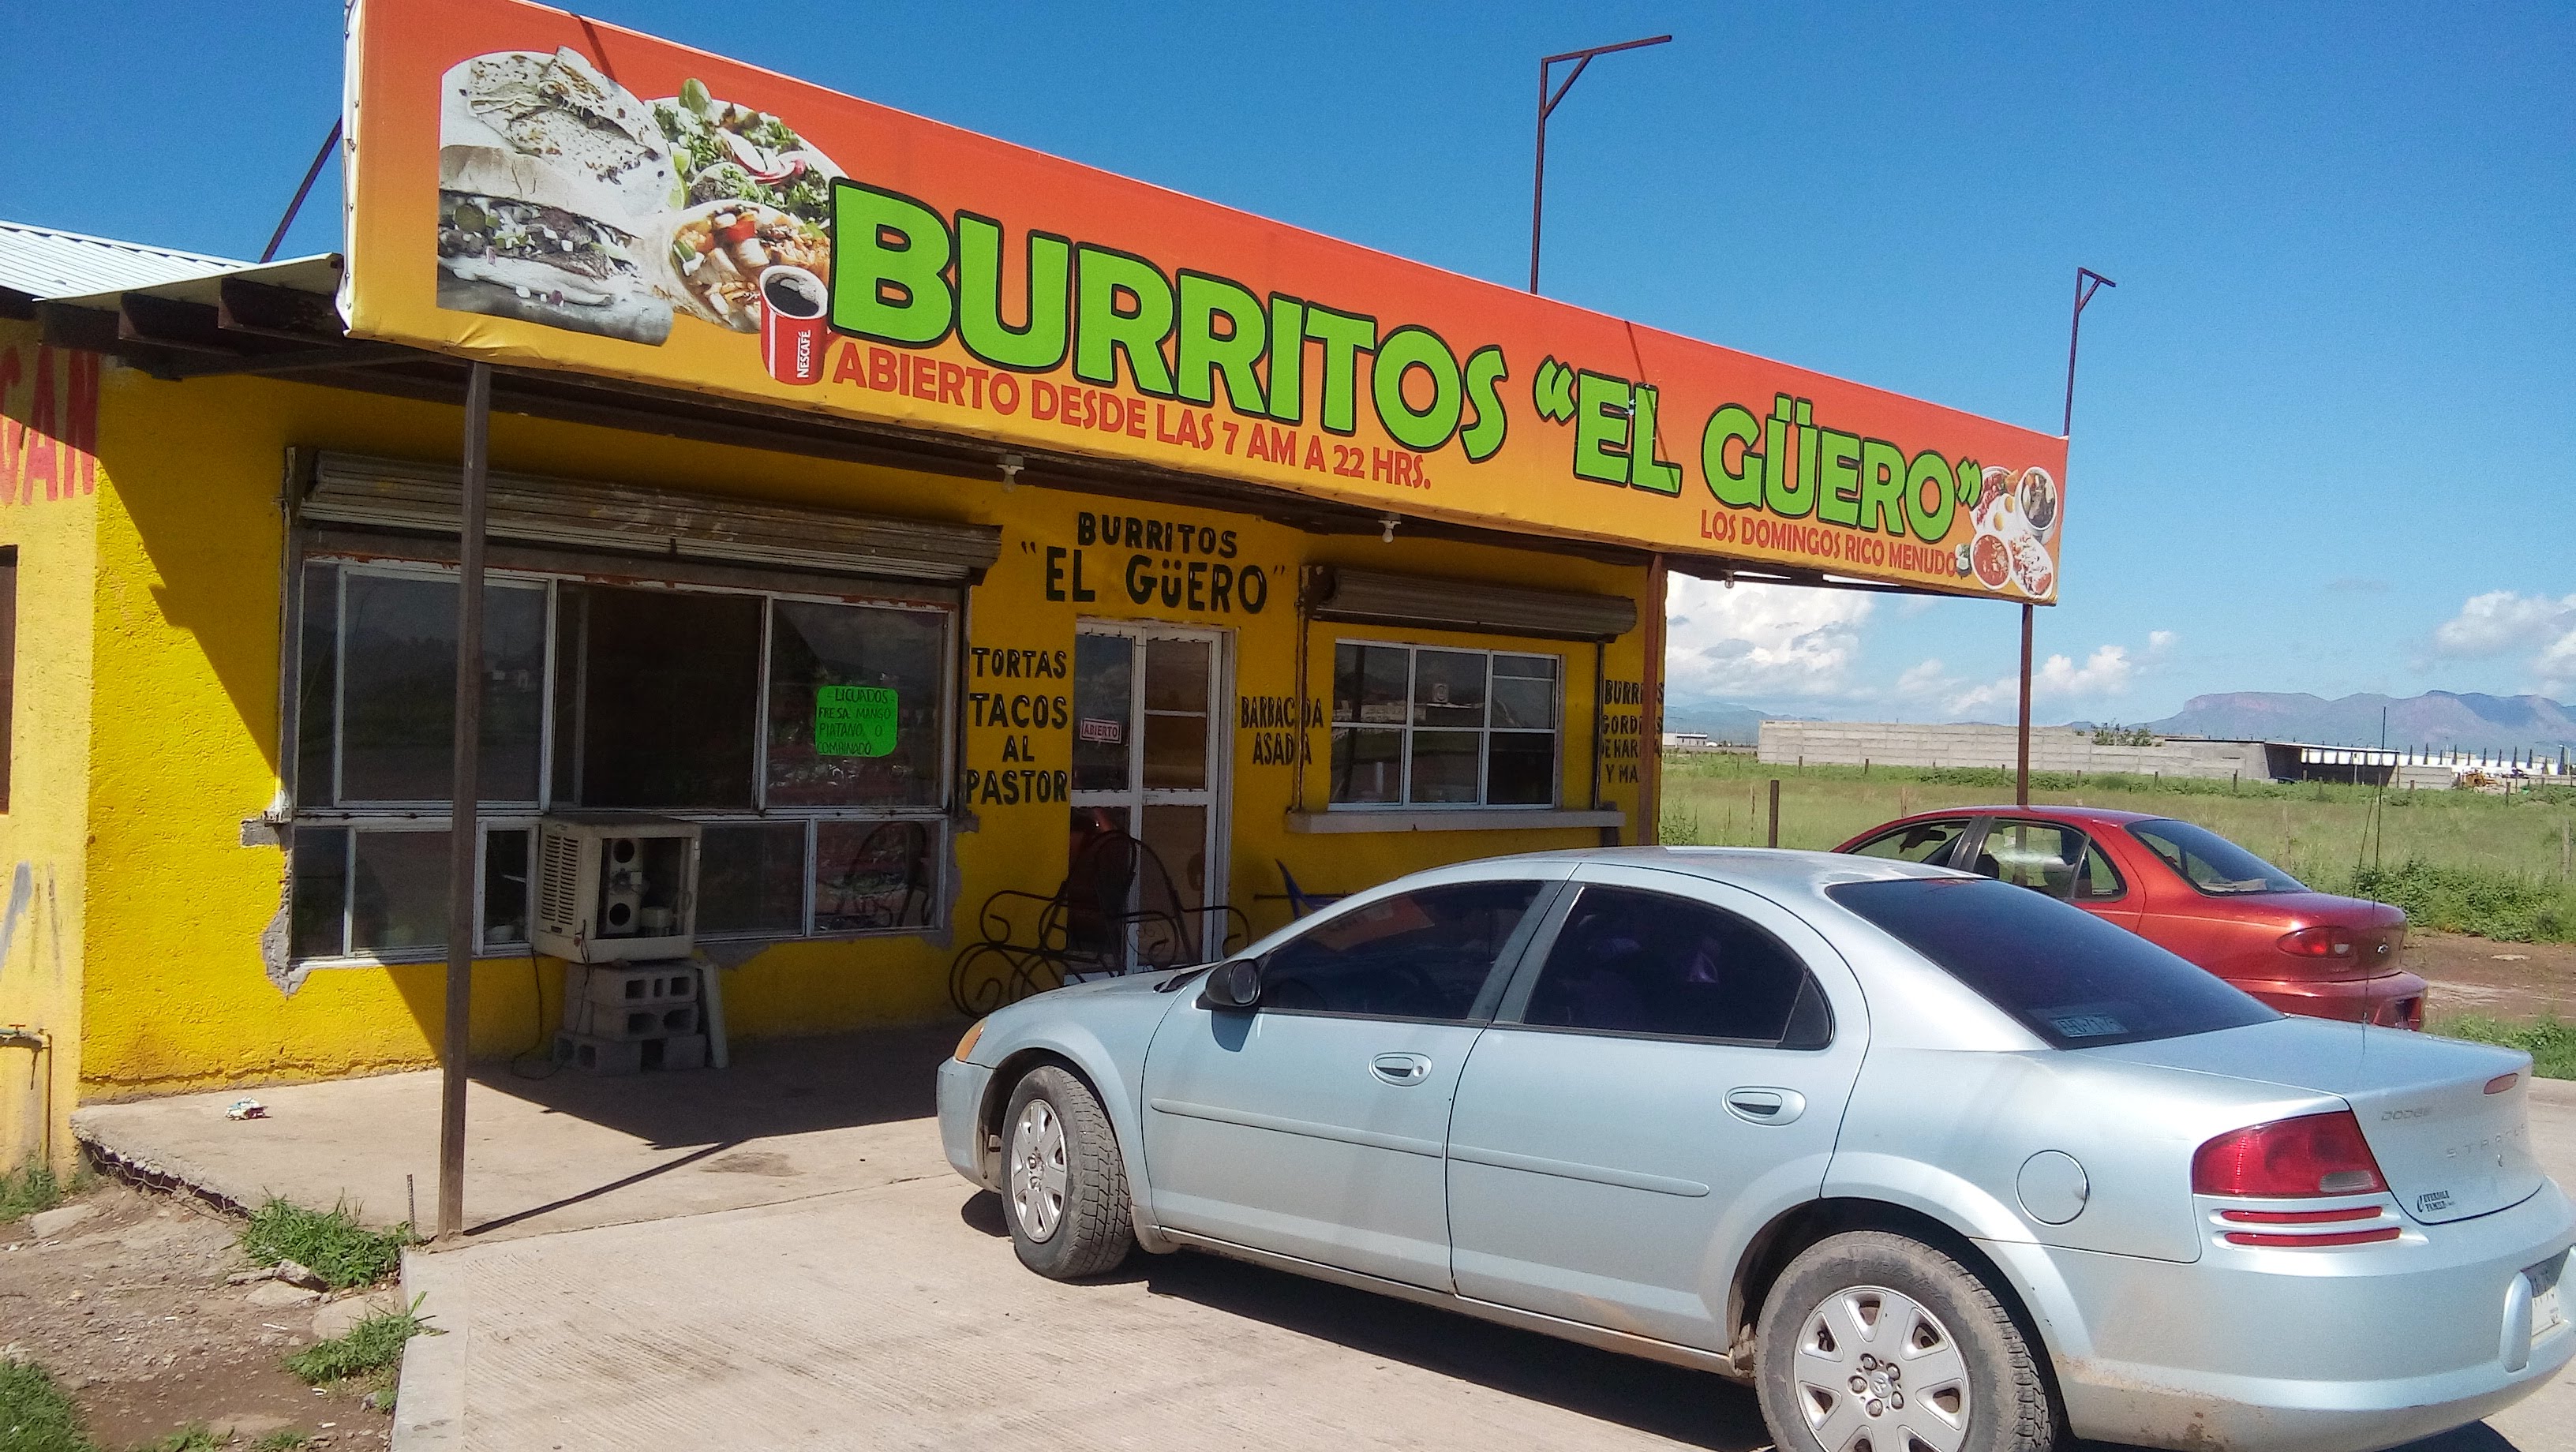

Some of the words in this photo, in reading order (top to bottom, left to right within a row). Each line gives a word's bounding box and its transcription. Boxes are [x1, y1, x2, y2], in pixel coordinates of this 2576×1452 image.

[796, 329, 811, 378] NESCAFÉ
[829, 177, 1508, 463] BURRITOS
[1533, 355, 1682, 496] “EL
[1702, 392, 1983, 544] GÜERO”
[833, 342, 1020, 415] ABIERTO
[1032, 380, 1146, 439] DESDE
[1156, 403, 1214, 451] LAS
[1222, 421, 1239, 455] 7
[1246, 423, 1296, 466] AM
[1304, 435, 1326, 473] A
[1333, 444, 1365, 479] 22
[1372, 447, 1431, 489] HRS.
[1078, 511, 1237, 559] BURRITOS
[1701, 509, 1736, 543] LOS
[1742, 516, 1840, 559] DOMINGOS
[1845, 534, 1885, 567] RICO
[1889, 542, 1956, 577] MENUDO
[971, 647, 1067, 679] TORTAS
[856, 708, 890, 720] MANGO
[969, 693, 1068, 729] TACOS
[1002, 735, 1035, 762] AL
[1084, 724, 1118, 738] ABIERTO
[967, 769, 1068, 805] PASTOR
[1605, 764, 1615, 784] Y
